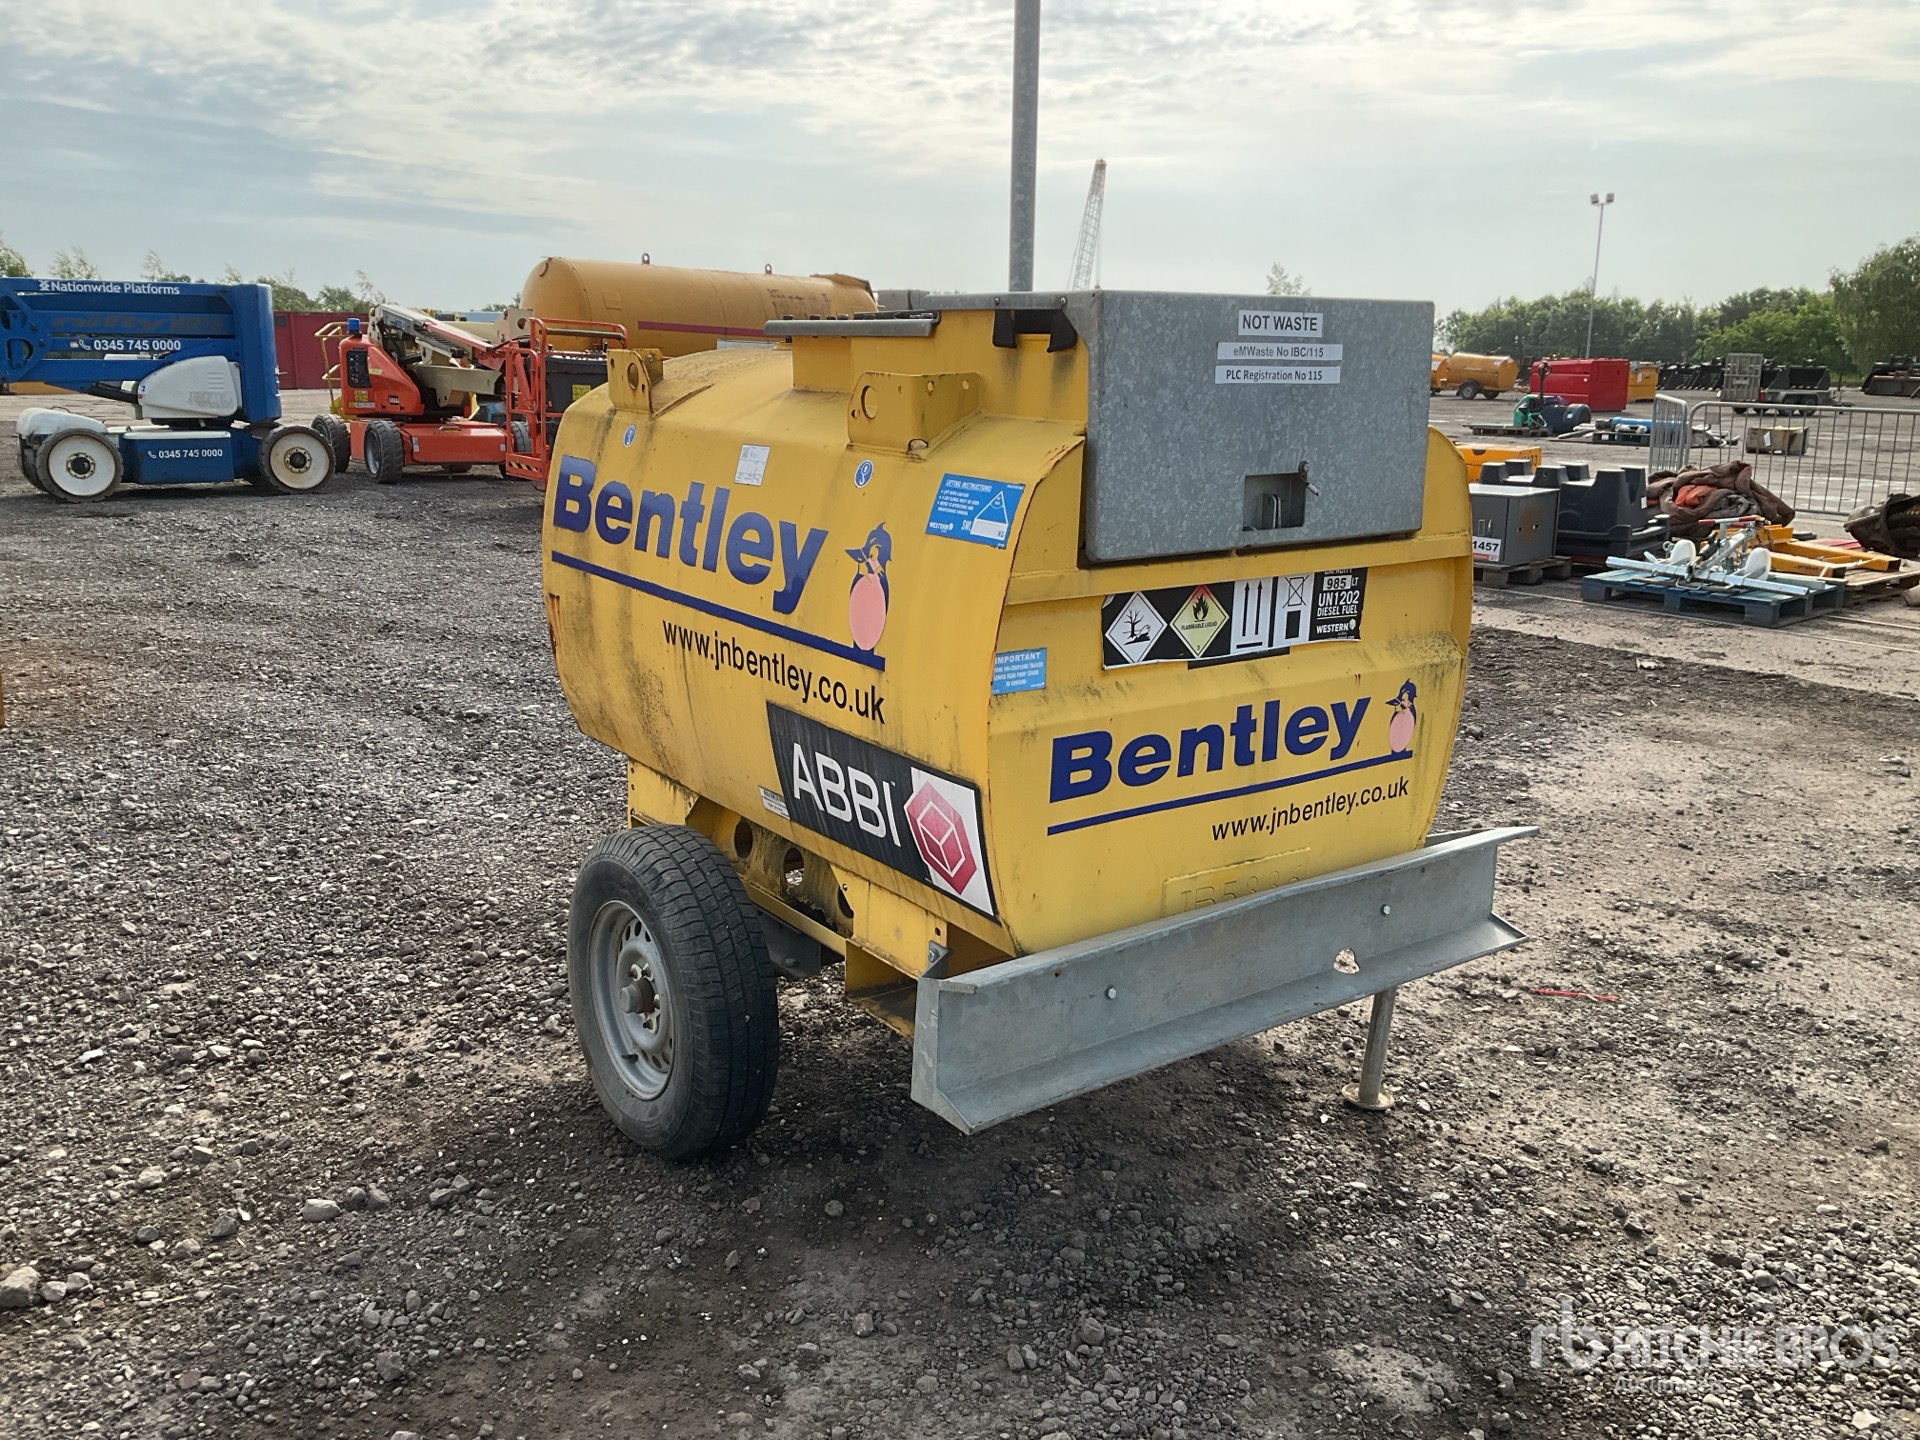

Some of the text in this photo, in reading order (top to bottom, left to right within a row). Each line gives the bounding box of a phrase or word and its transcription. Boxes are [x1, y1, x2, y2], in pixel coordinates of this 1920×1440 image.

[51, 281, 180, 295] Nationwide Platforms
[1242, 315, 1318, 331] NOT WASTE
[93, 340, 181, 351] 0345 745 0000
[1233, 346, 1324, 358] eMWaste No IBC/115
[1226, 370, 1322, 382] PLC Registration No 115
[158, 449, 223, 459] 0345 745 0000
[553, 455, 829, 615] Bentley
[1472, 540, 1500, 552] 1457
[1327, 576, 1359, 589] 985 LT
[1318, 590, 1360, 607] UN1202
[1317, 604, 1358, 617] DIESEL FUEL
[1181, 622, 1205, 630] FLAMMABLE
[1316, 622, 1349, 634] WESTERN
[994, 651, 1041, 665] IMPORTANT
[662, 620, 885, 724] www.jnbentley.co.uk
[1049, 697, 1371, 803] Bentley
[1211, 776, 1409, 841] www.jnbentley.co.uk
